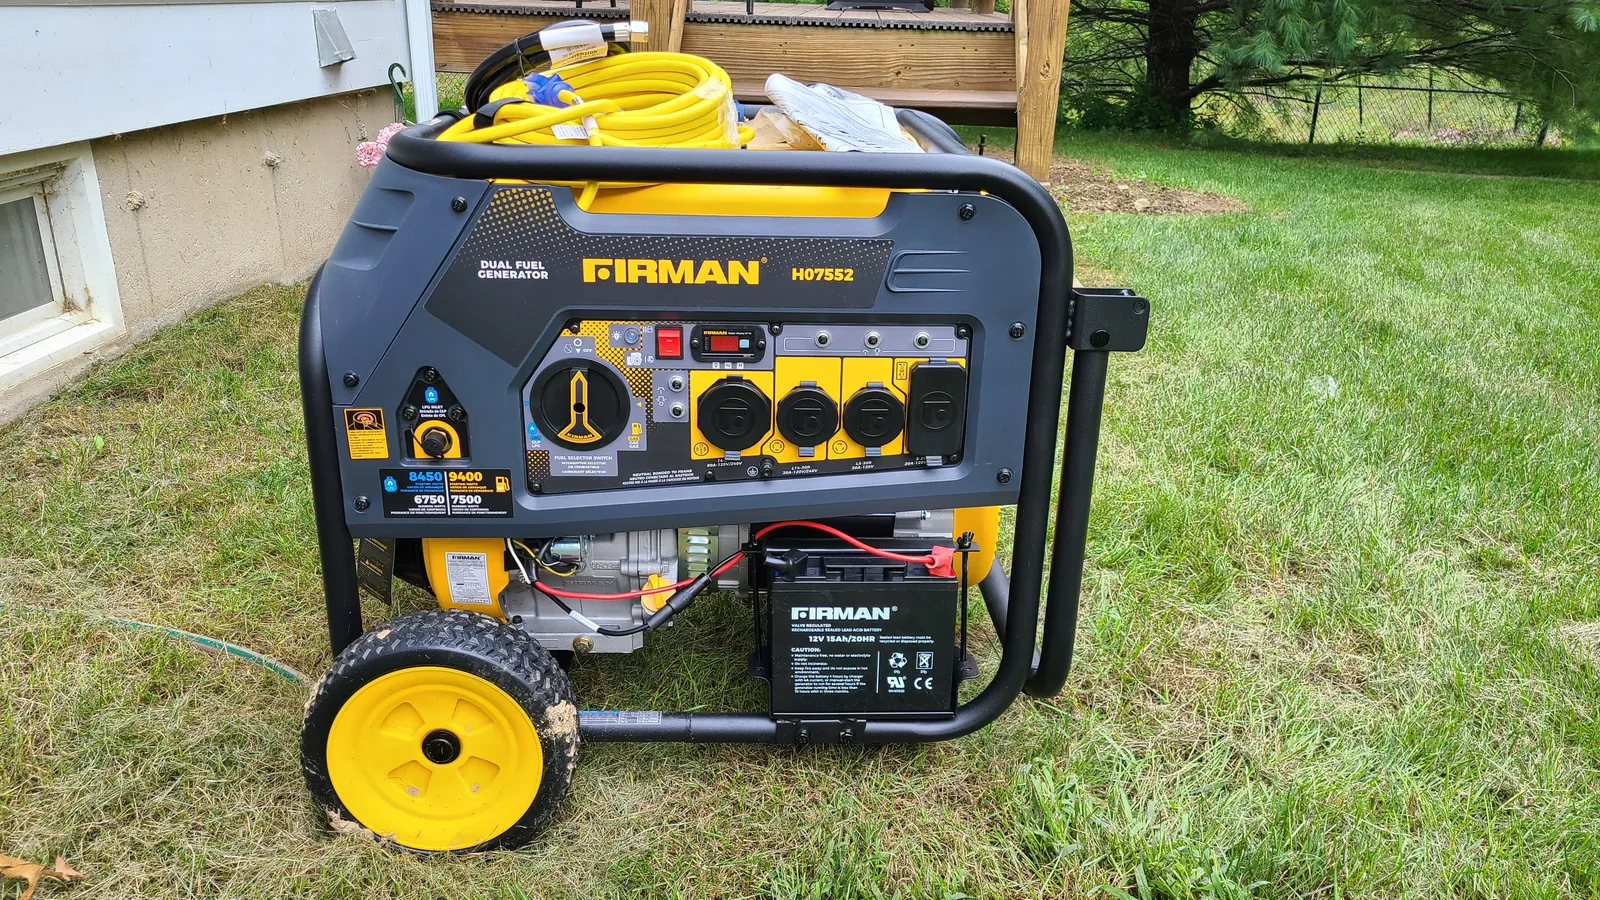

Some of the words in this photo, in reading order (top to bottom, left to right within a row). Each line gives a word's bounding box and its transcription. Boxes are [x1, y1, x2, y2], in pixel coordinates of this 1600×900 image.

[480, 260, 512, 269] DUAL
[515, 260, 545, 270] FUEL
[477, 269, 549, 279] GENERATOR
[791, 267, 854, 281] H07552
[408, 471, 443, 481] 8450
[448, 472, 483, 482] 9400
[414, 495, 445, 504] 6750
[450, 495, 482, 504] 7500
[791, 607, 890, 620] FIRMAN
[809, 635, 824, 643] 12V
[826, 635, 876, 643] 15Ah/20HR
